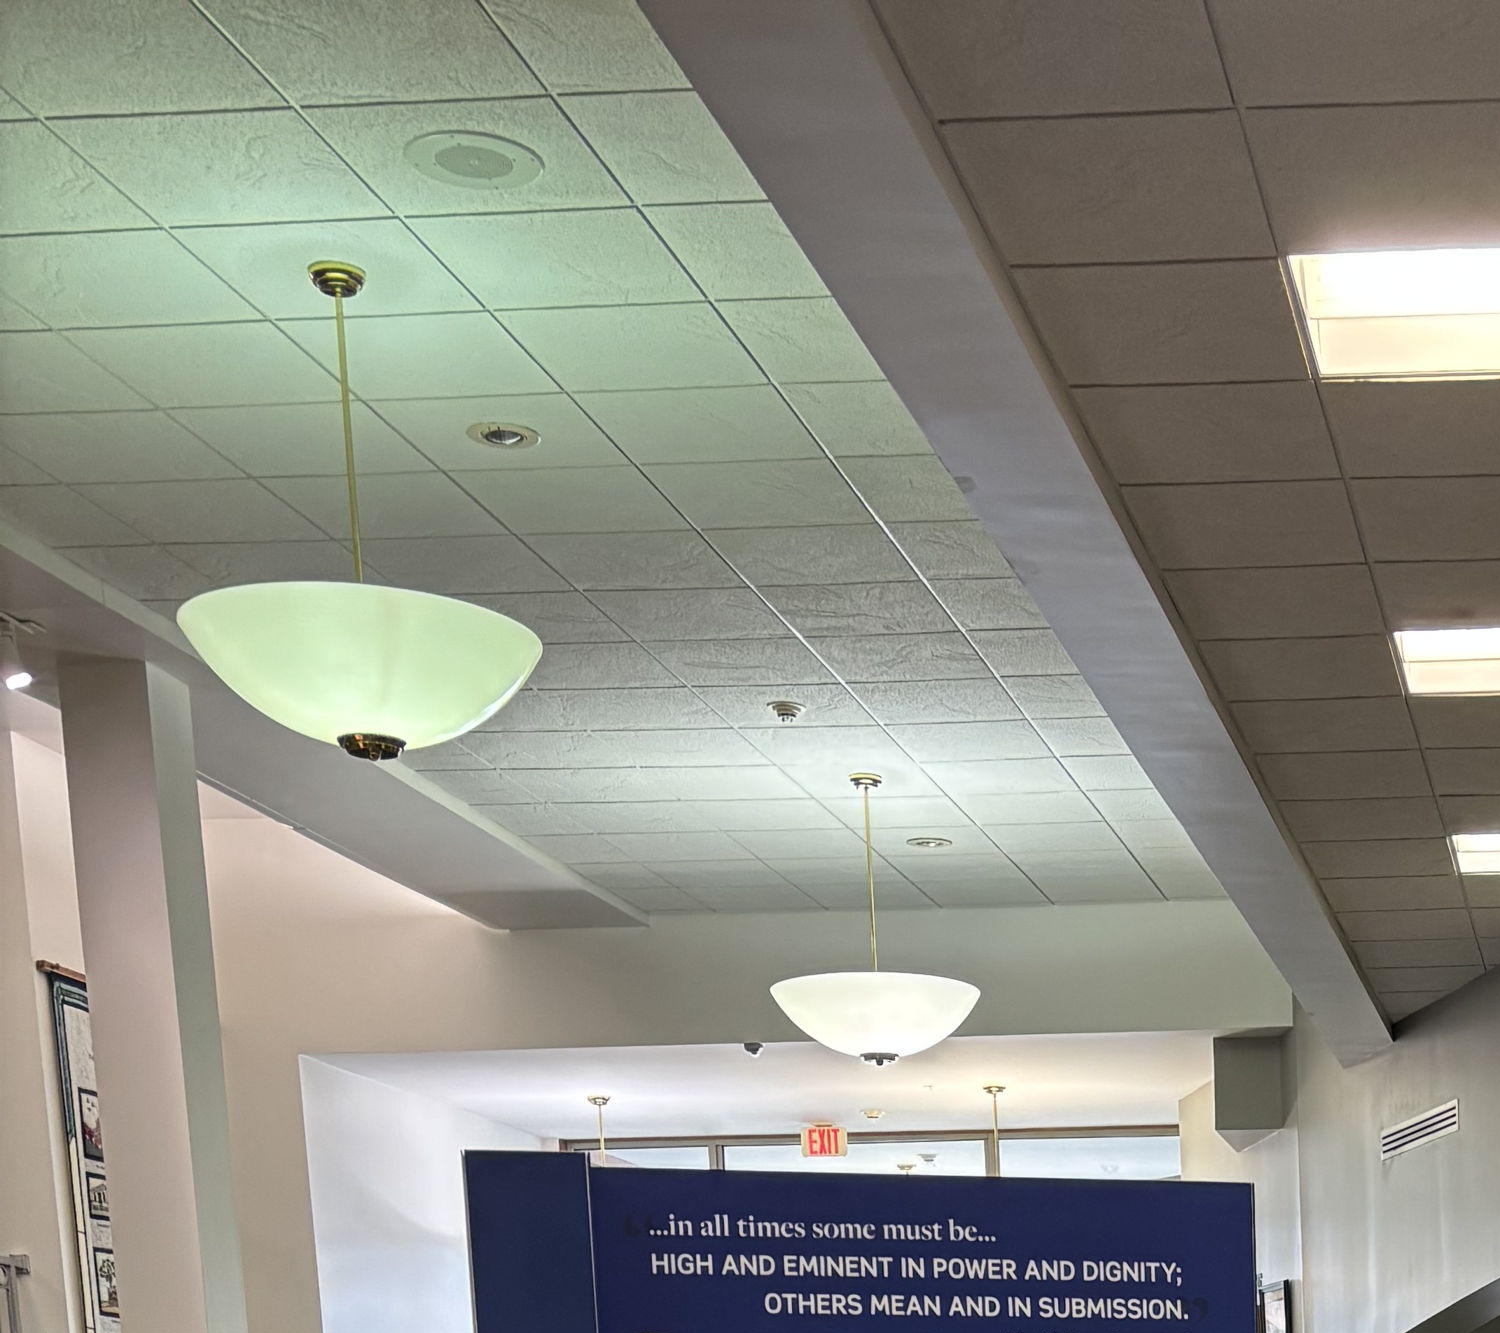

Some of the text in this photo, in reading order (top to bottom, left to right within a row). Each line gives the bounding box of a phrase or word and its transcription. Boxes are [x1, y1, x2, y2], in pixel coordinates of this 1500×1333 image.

[808, 1129, 839, 1154] EXIT
[650, 1214, 995, 1241] ...in all times some must be...
[652, 1254, 1181, 1286] HIGH AND EMINENT IN POWER AND DIGNITY;
[765, 1293, 1188, 1319] OTHERS MEAN AND IN SUBMISSION.
